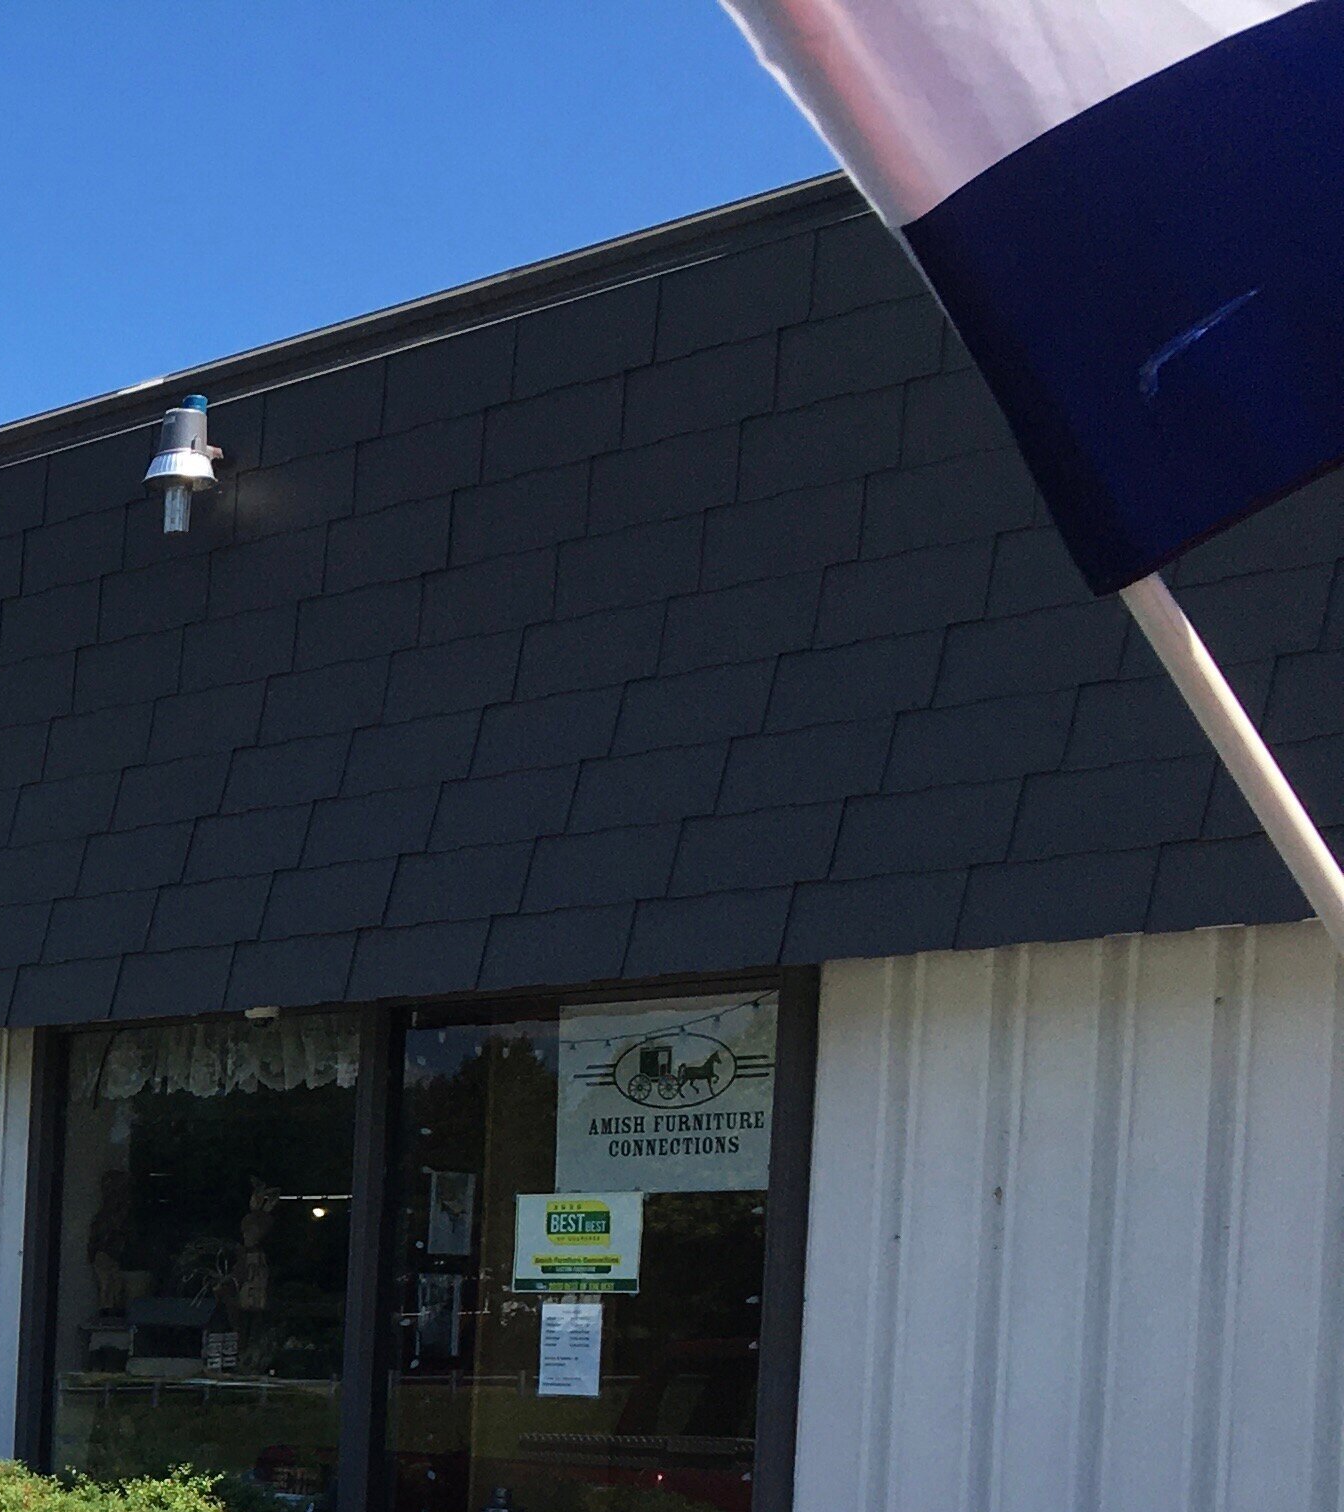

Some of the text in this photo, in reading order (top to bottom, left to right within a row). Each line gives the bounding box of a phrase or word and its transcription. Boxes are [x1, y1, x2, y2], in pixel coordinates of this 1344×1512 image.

[588, 1110, 765, 1136] AMISH FURNITURE
[608, 1135, 740, 1158] CONNECTIONS
[550, 1213, 607, 1233] BEST BEST
